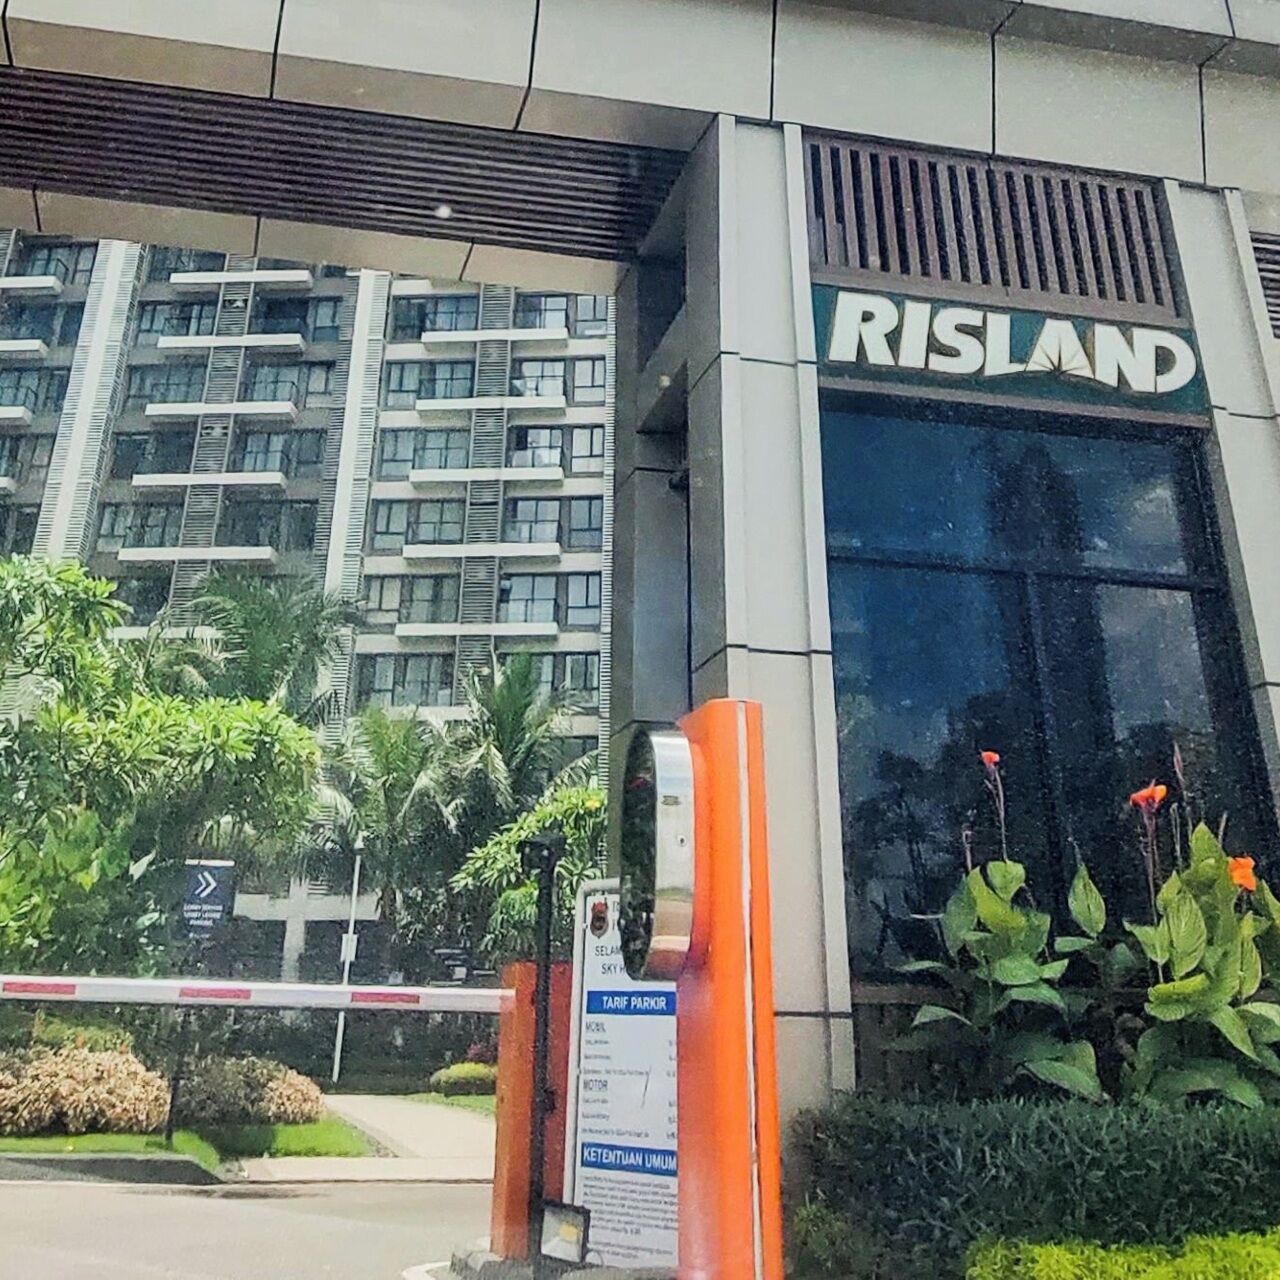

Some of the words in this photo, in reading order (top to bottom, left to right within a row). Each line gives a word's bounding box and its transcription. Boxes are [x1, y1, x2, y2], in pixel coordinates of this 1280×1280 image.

[828, 291, 1197, 394] RISLAND
[602, 995, 629, 1009] TARIF
[631, 996, 667, 1010] PARKIR
[583, 1146, 643, 1165] KETENTUAN
[645, 1154, 677, 1170] UMUM
